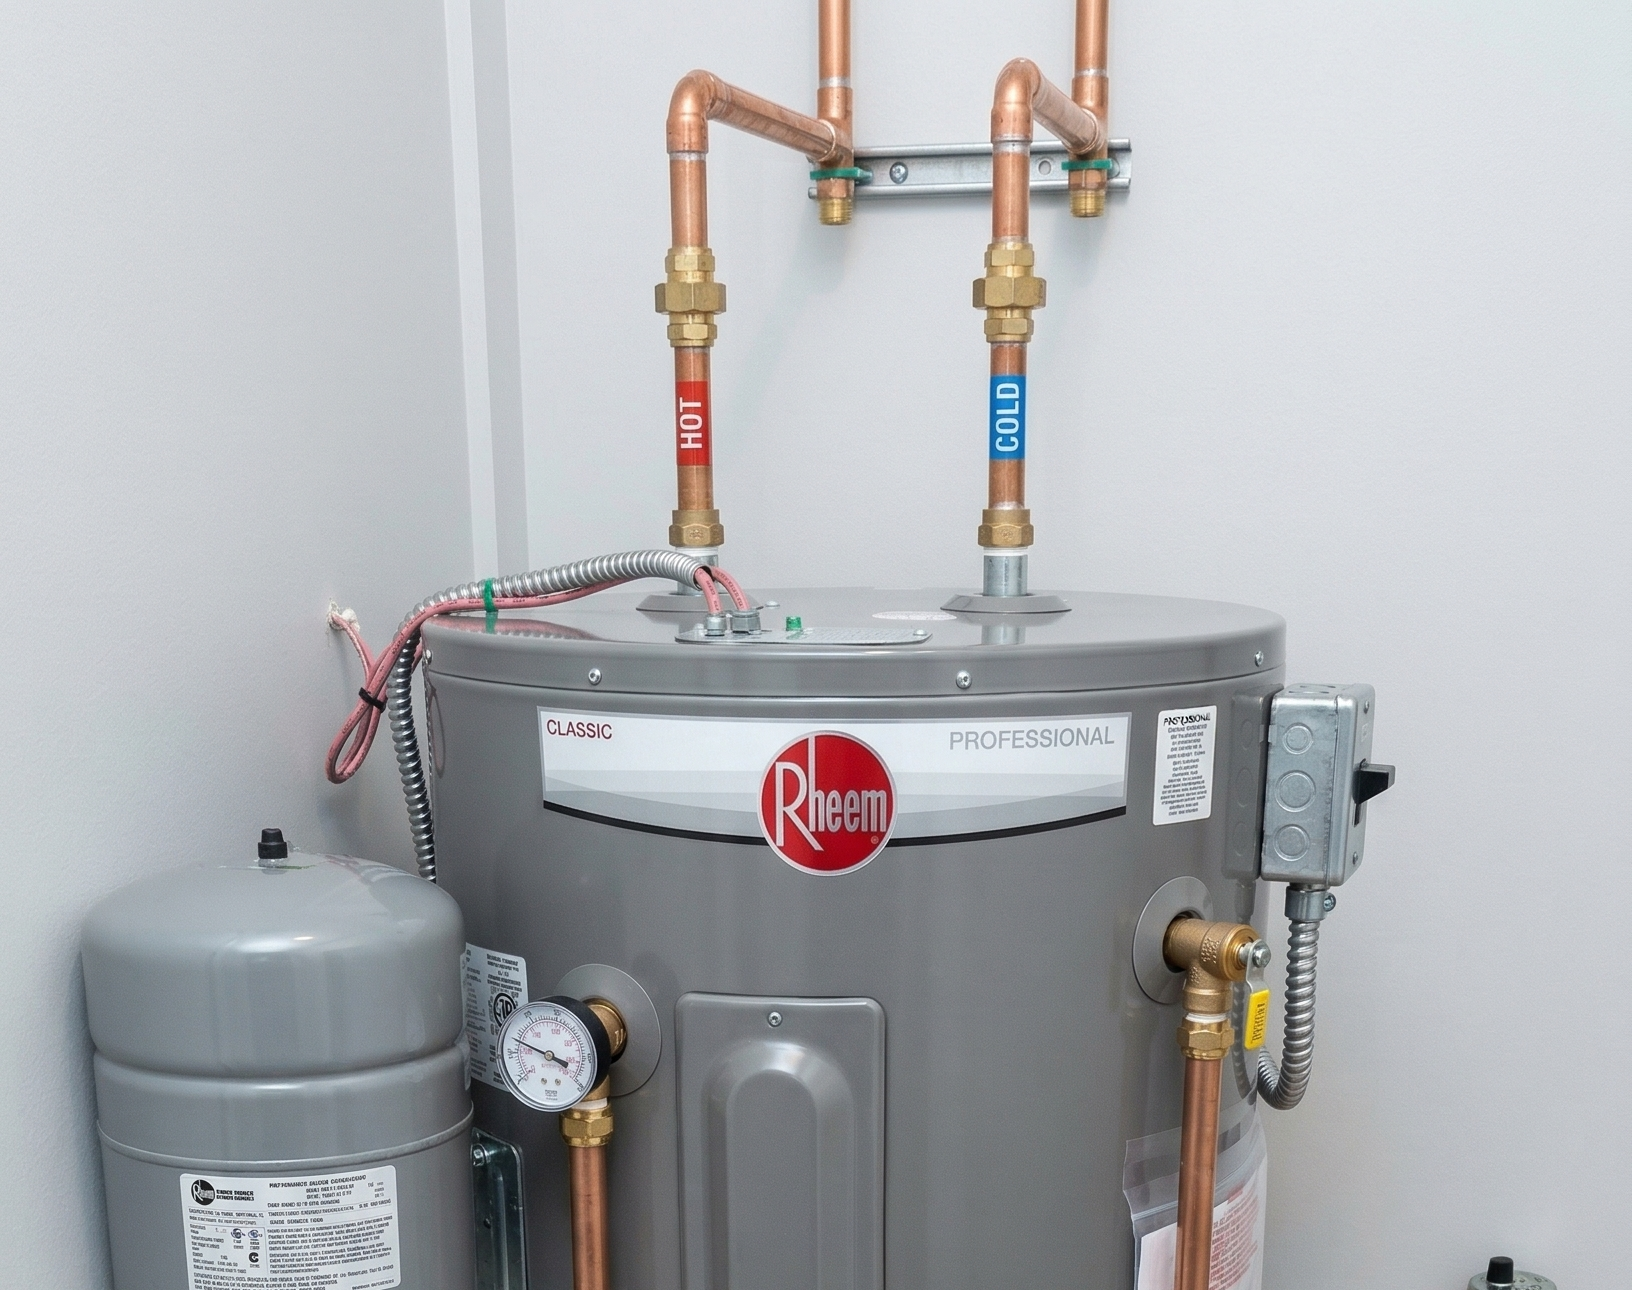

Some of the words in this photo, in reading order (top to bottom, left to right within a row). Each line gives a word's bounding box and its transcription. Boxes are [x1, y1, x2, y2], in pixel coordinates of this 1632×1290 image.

[679, 397, 703, 449] HOT
[995, 382, 1020, 452] COLD
[547, 719, 612, 739] CLASSIC
[950, 726, 1114, 750] PROFESSIONAL
[775, 735, 887, 852] Rheem
